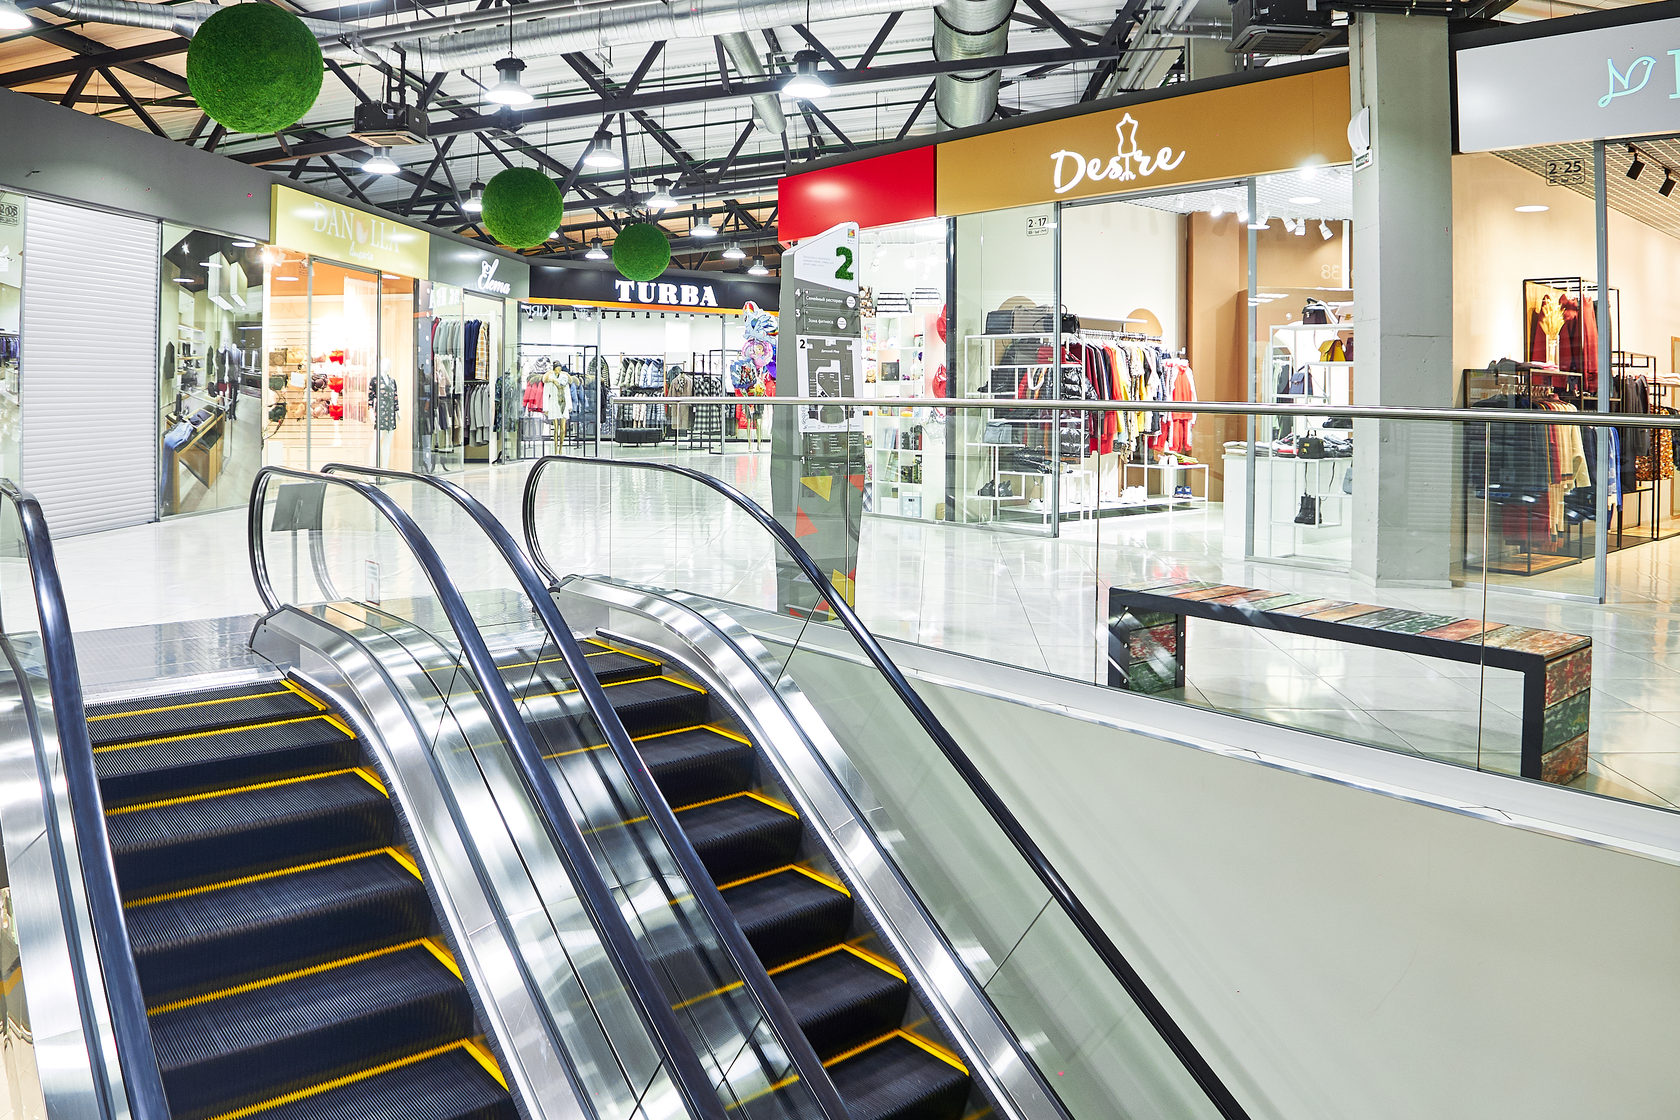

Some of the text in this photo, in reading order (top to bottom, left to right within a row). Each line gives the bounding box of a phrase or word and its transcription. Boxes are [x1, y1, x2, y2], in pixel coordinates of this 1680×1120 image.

[1051, 113, 1186, 193] Desire
[835, 246, 854, 281] 2
[614, 279, 719, 307] TURBA
[795, 288, 801, 297] 4
[795, 308, 801, 318] 3
[799, 339, 806, 349] 2
